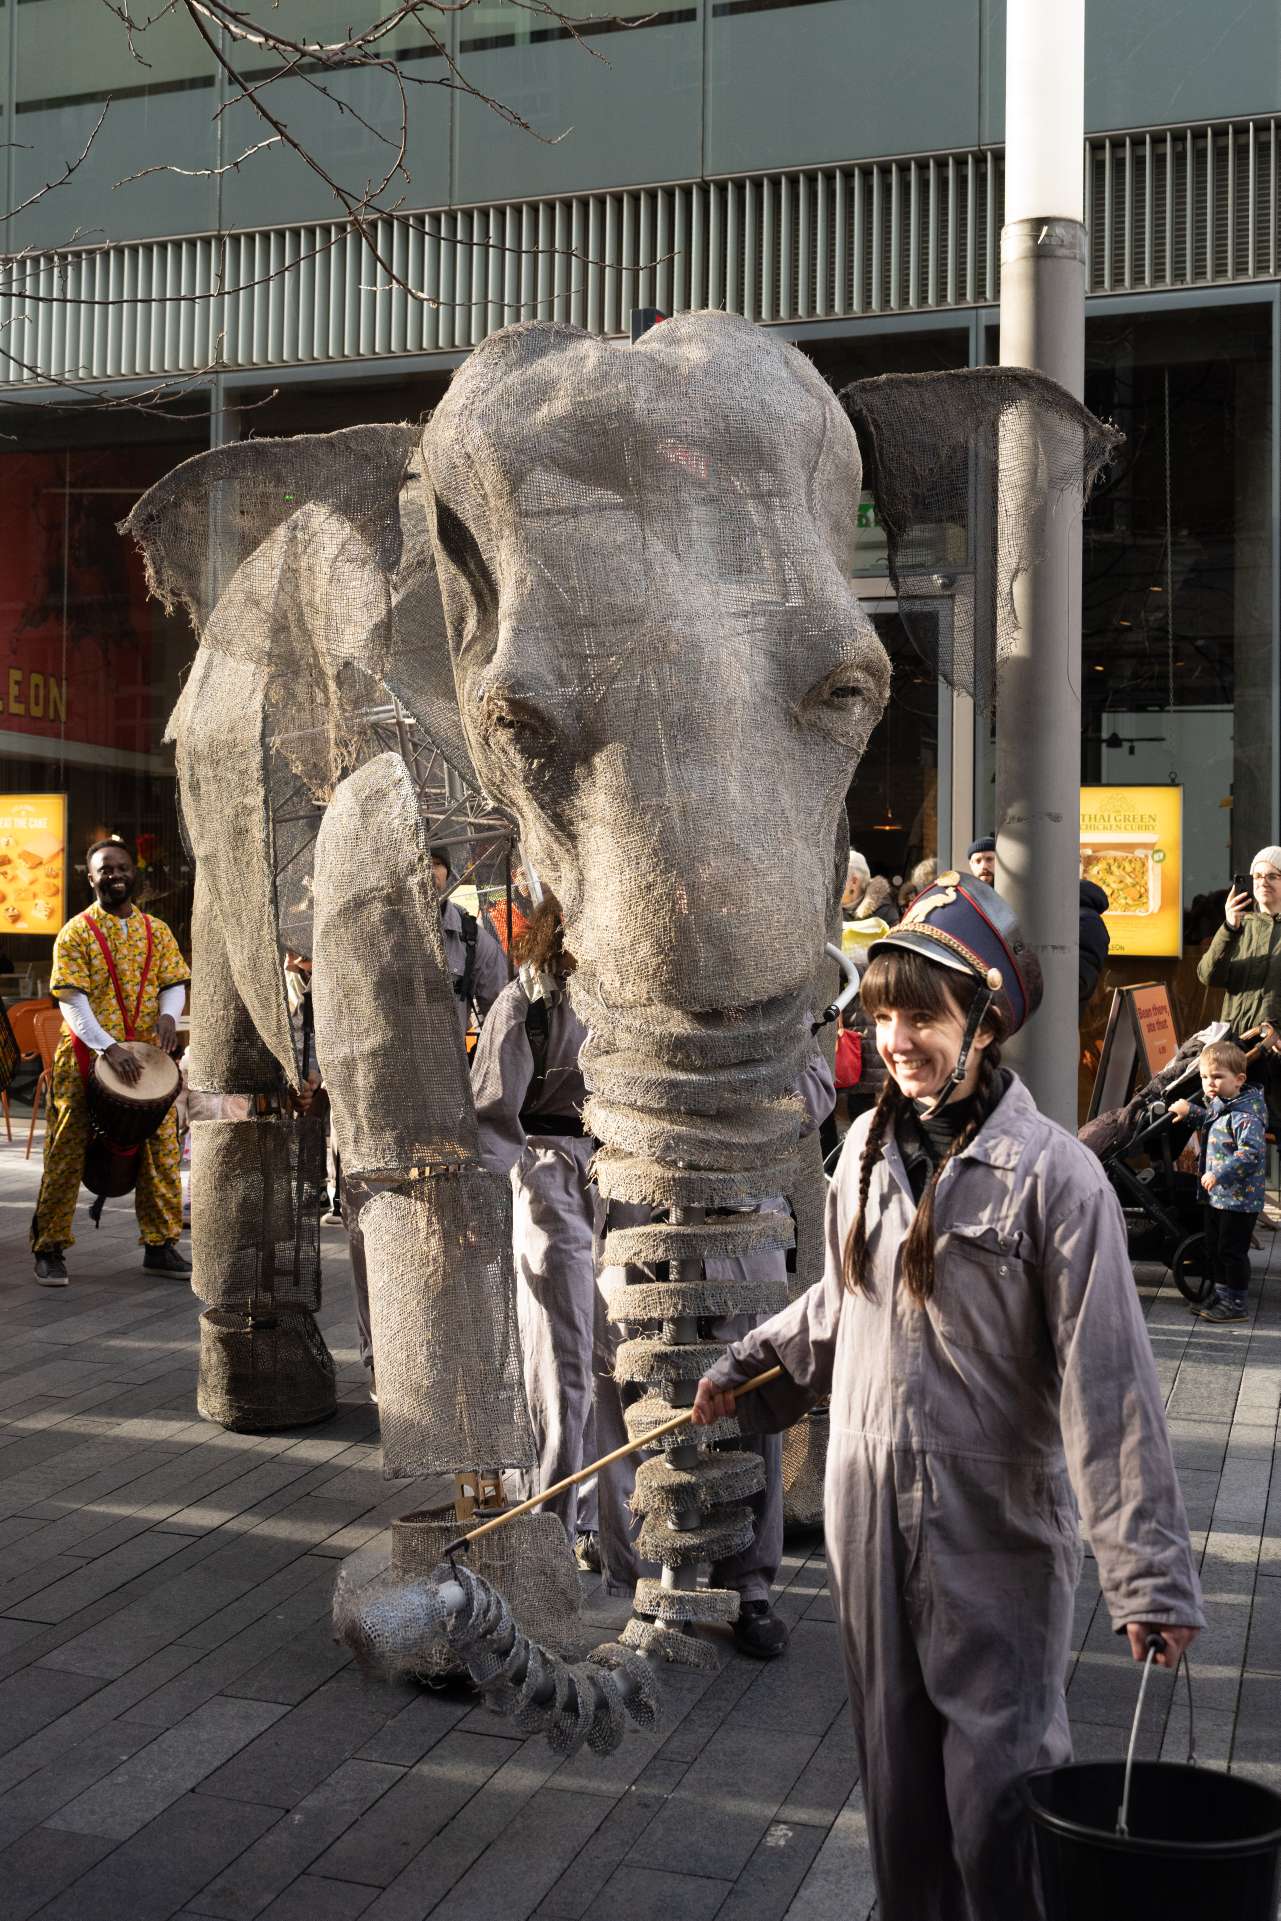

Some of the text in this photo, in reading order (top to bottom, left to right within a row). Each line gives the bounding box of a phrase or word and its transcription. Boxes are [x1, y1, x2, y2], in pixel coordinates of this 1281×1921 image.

[0, 668, 67, 721] EON
[1081, 813, 1157, 823] THAI GREEN
[1124, 823, 1156, 832] CURRY
